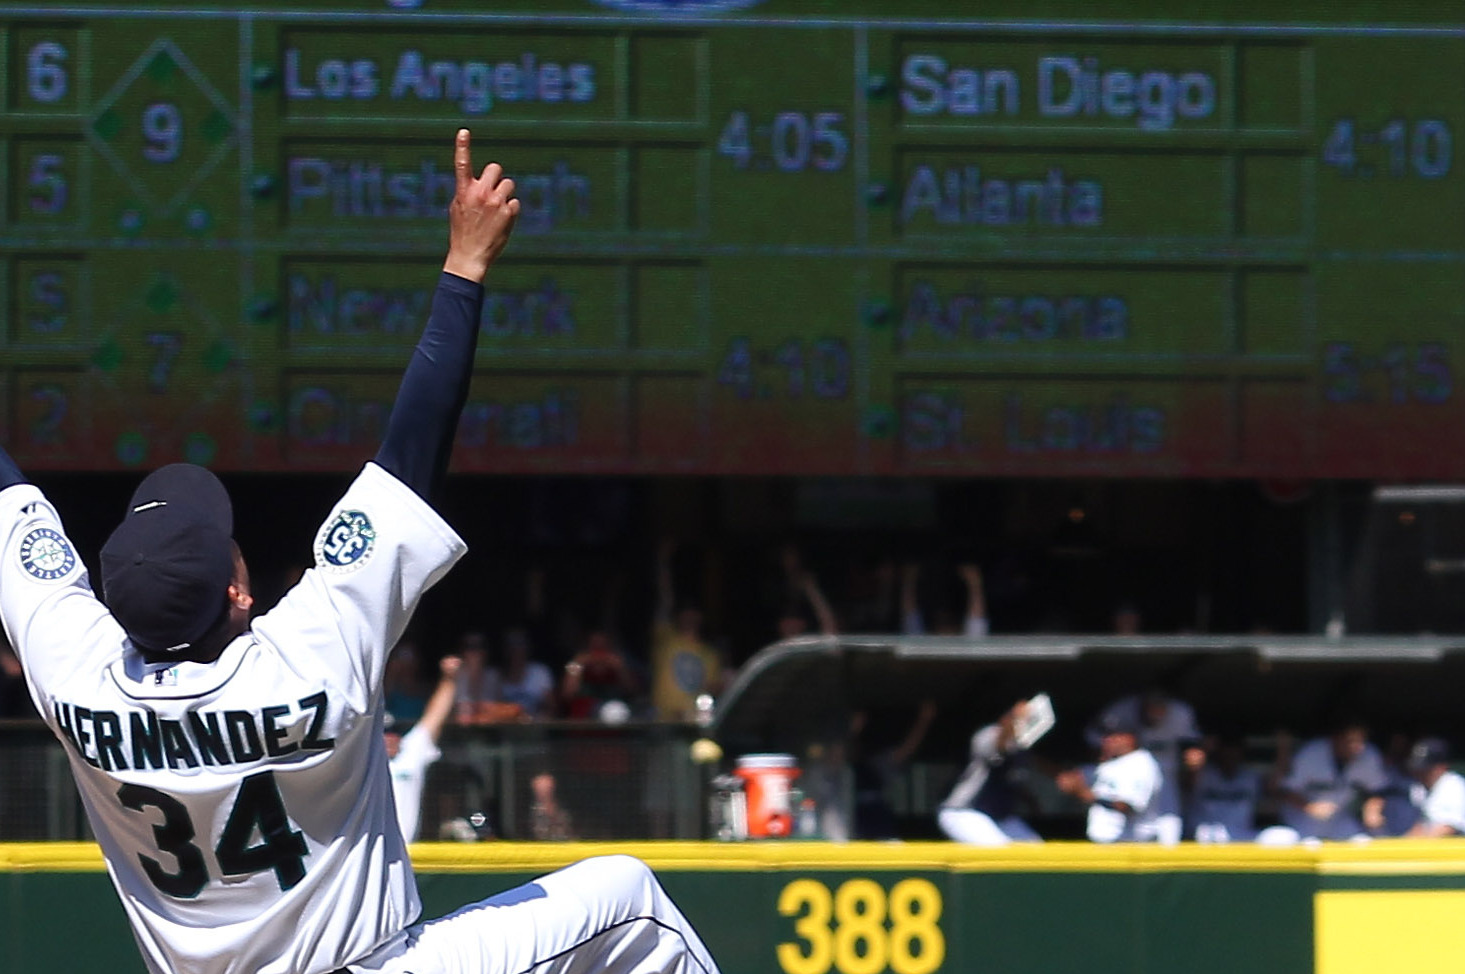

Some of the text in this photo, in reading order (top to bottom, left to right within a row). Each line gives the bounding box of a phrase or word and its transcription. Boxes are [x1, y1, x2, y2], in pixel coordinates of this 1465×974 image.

[26, 41, 68, 103] 6
[285, 47, 596, 115] Los Angeles
[900, 54, 1218, 132] San Diego
[140, 102, 183, 165] 9
[716, 111, 849, 172] 4:05
[1322, 118, 1452, 179] 4:10
[27, 154, 69, 215] 5
[898, 165, 1104, 229] Atlanta
[53, 690, 335, 772] HERNANDEZ
[117, 769, 310, 899] 34
